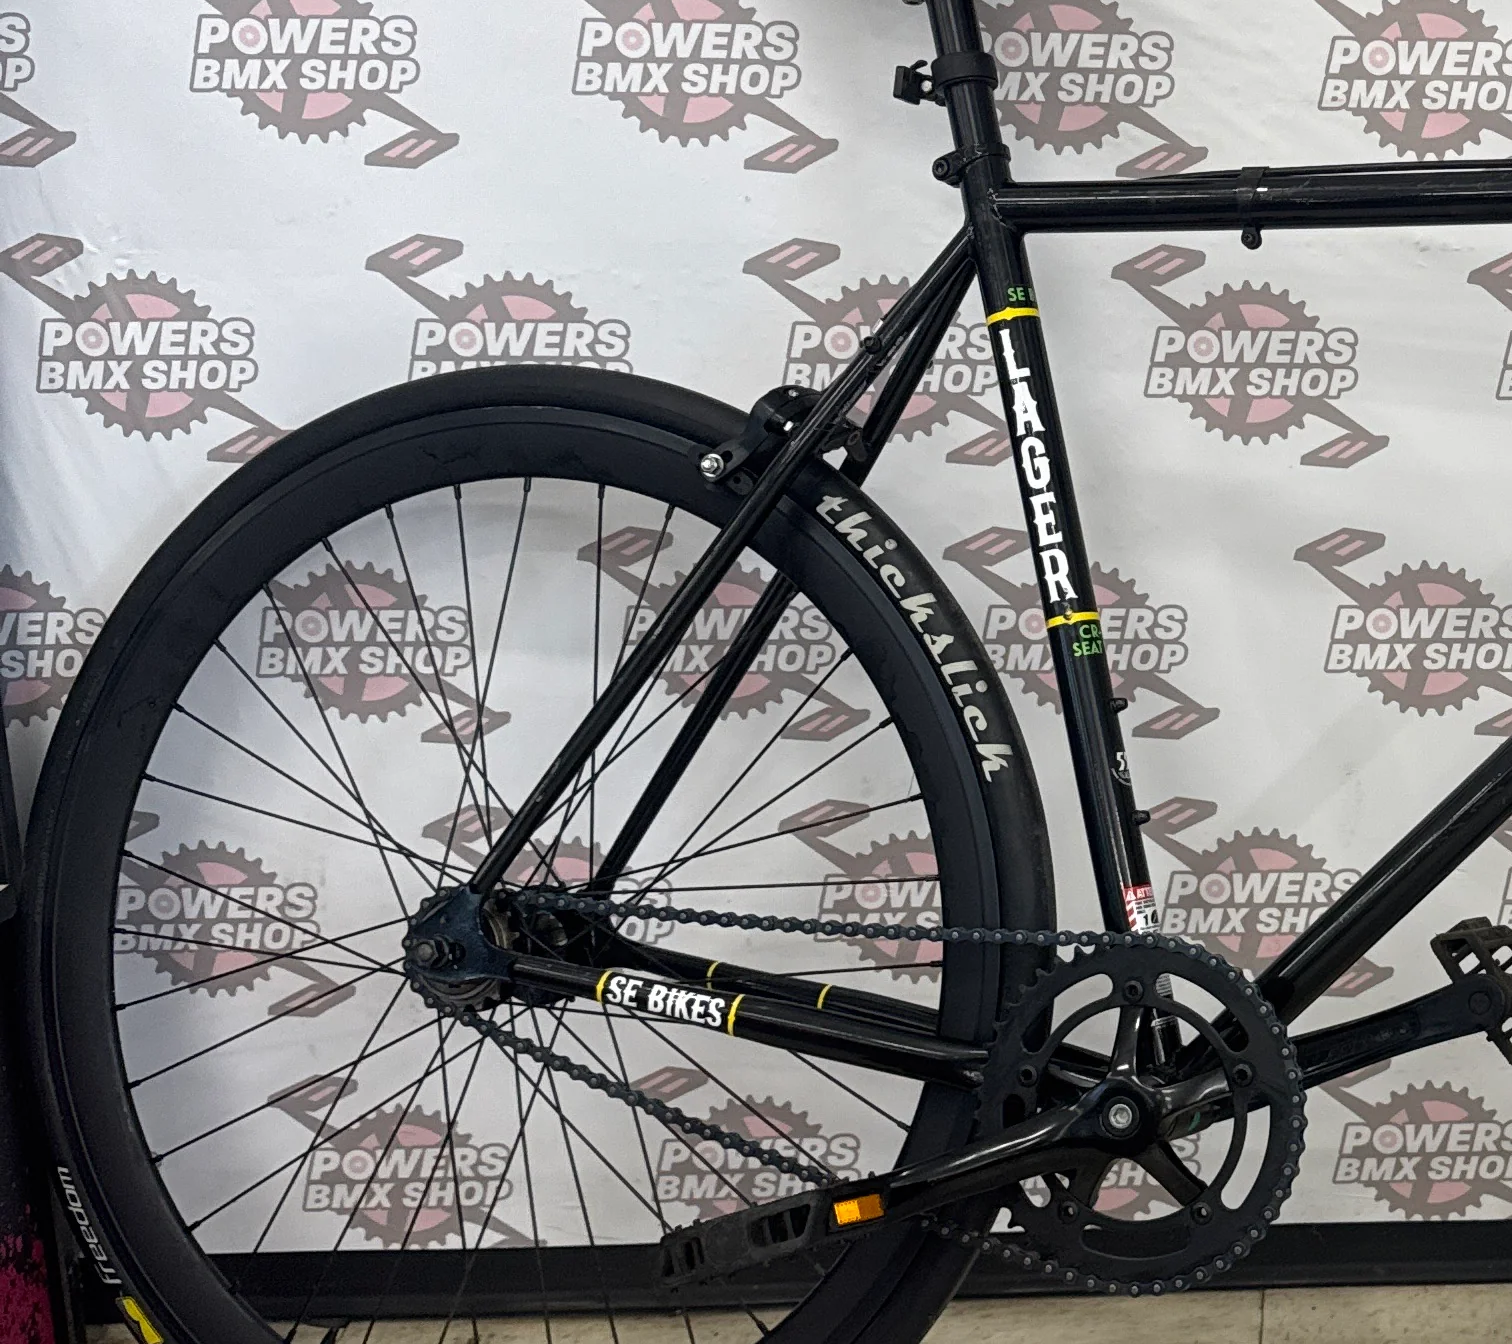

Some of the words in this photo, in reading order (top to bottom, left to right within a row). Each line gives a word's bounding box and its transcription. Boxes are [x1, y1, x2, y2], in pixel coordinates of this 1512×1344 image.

[198, 18, 412, 55] POWERS
[582, 22, 794, 60] POWERS
[985, 32, 1172, 70] OWERS
[194, 59, 291, 89] BMX
[300, 59, 415, 90] SHOP
[577, 62, 673, 93] BMX
[681, 63, 797, 95] SHOP
[995, 73, 1046, 102] MX
[1058, 72, 1172, 104] SHOP
[1323, 80, 1415, 109] BMX
[43, 322, 250, 356] POWERS
[416, 322, 626, 357] POWERS
[793, 324, 993, 360] PORS
[1155, 330, 1353, 363] POWERS
[41, 361, 132, 389] BMX
[142, 360, 254, 389] SHOP
[922, 364, 997, 392] HOP
[1149, 368, 1239, 395] BMX
[1247, 368, 1354, 396] SHOP
[999, 329, 1078, 604] LAGER
[0, 612, 98, 646] ERS
[264, 610, 465, 642] POWERS
[986, 607, 1185, 640] POERS
[0, 651, 82, 678] SHO
[260, 647, 350, 674] BMX
[359, 646, 470, 674] SHOP
[749, 645, 833, 672] HOP
[1108, 644, 1185, 670] HOP
[1329, 644, 1416, 669] BMX
[118, 887, 313, 920] POWERS
[823, 878, 940, 909] POW
[1169, 872, 1358, 904] POWERS
[1161, 908, 1245, 932] BMX
[1256, 907, 1328, 933] SH
[114, 924, 202, 952] BMX
[211, 922, 314, 950] SHOP
[607, 975, 645, 1007] SE
[647, 984, 726, 1027] BIKES
[311, 1147, 507, 1180] POWERS
[1337, 1157, 1421, 1180] BMX
[307, 1183, 394, 1208] BMX
[402, 1181, 508, 1208] SHOP
[658, 1175, 740, 1199] BMX
[57, 1166, 122, 1284] freedom
